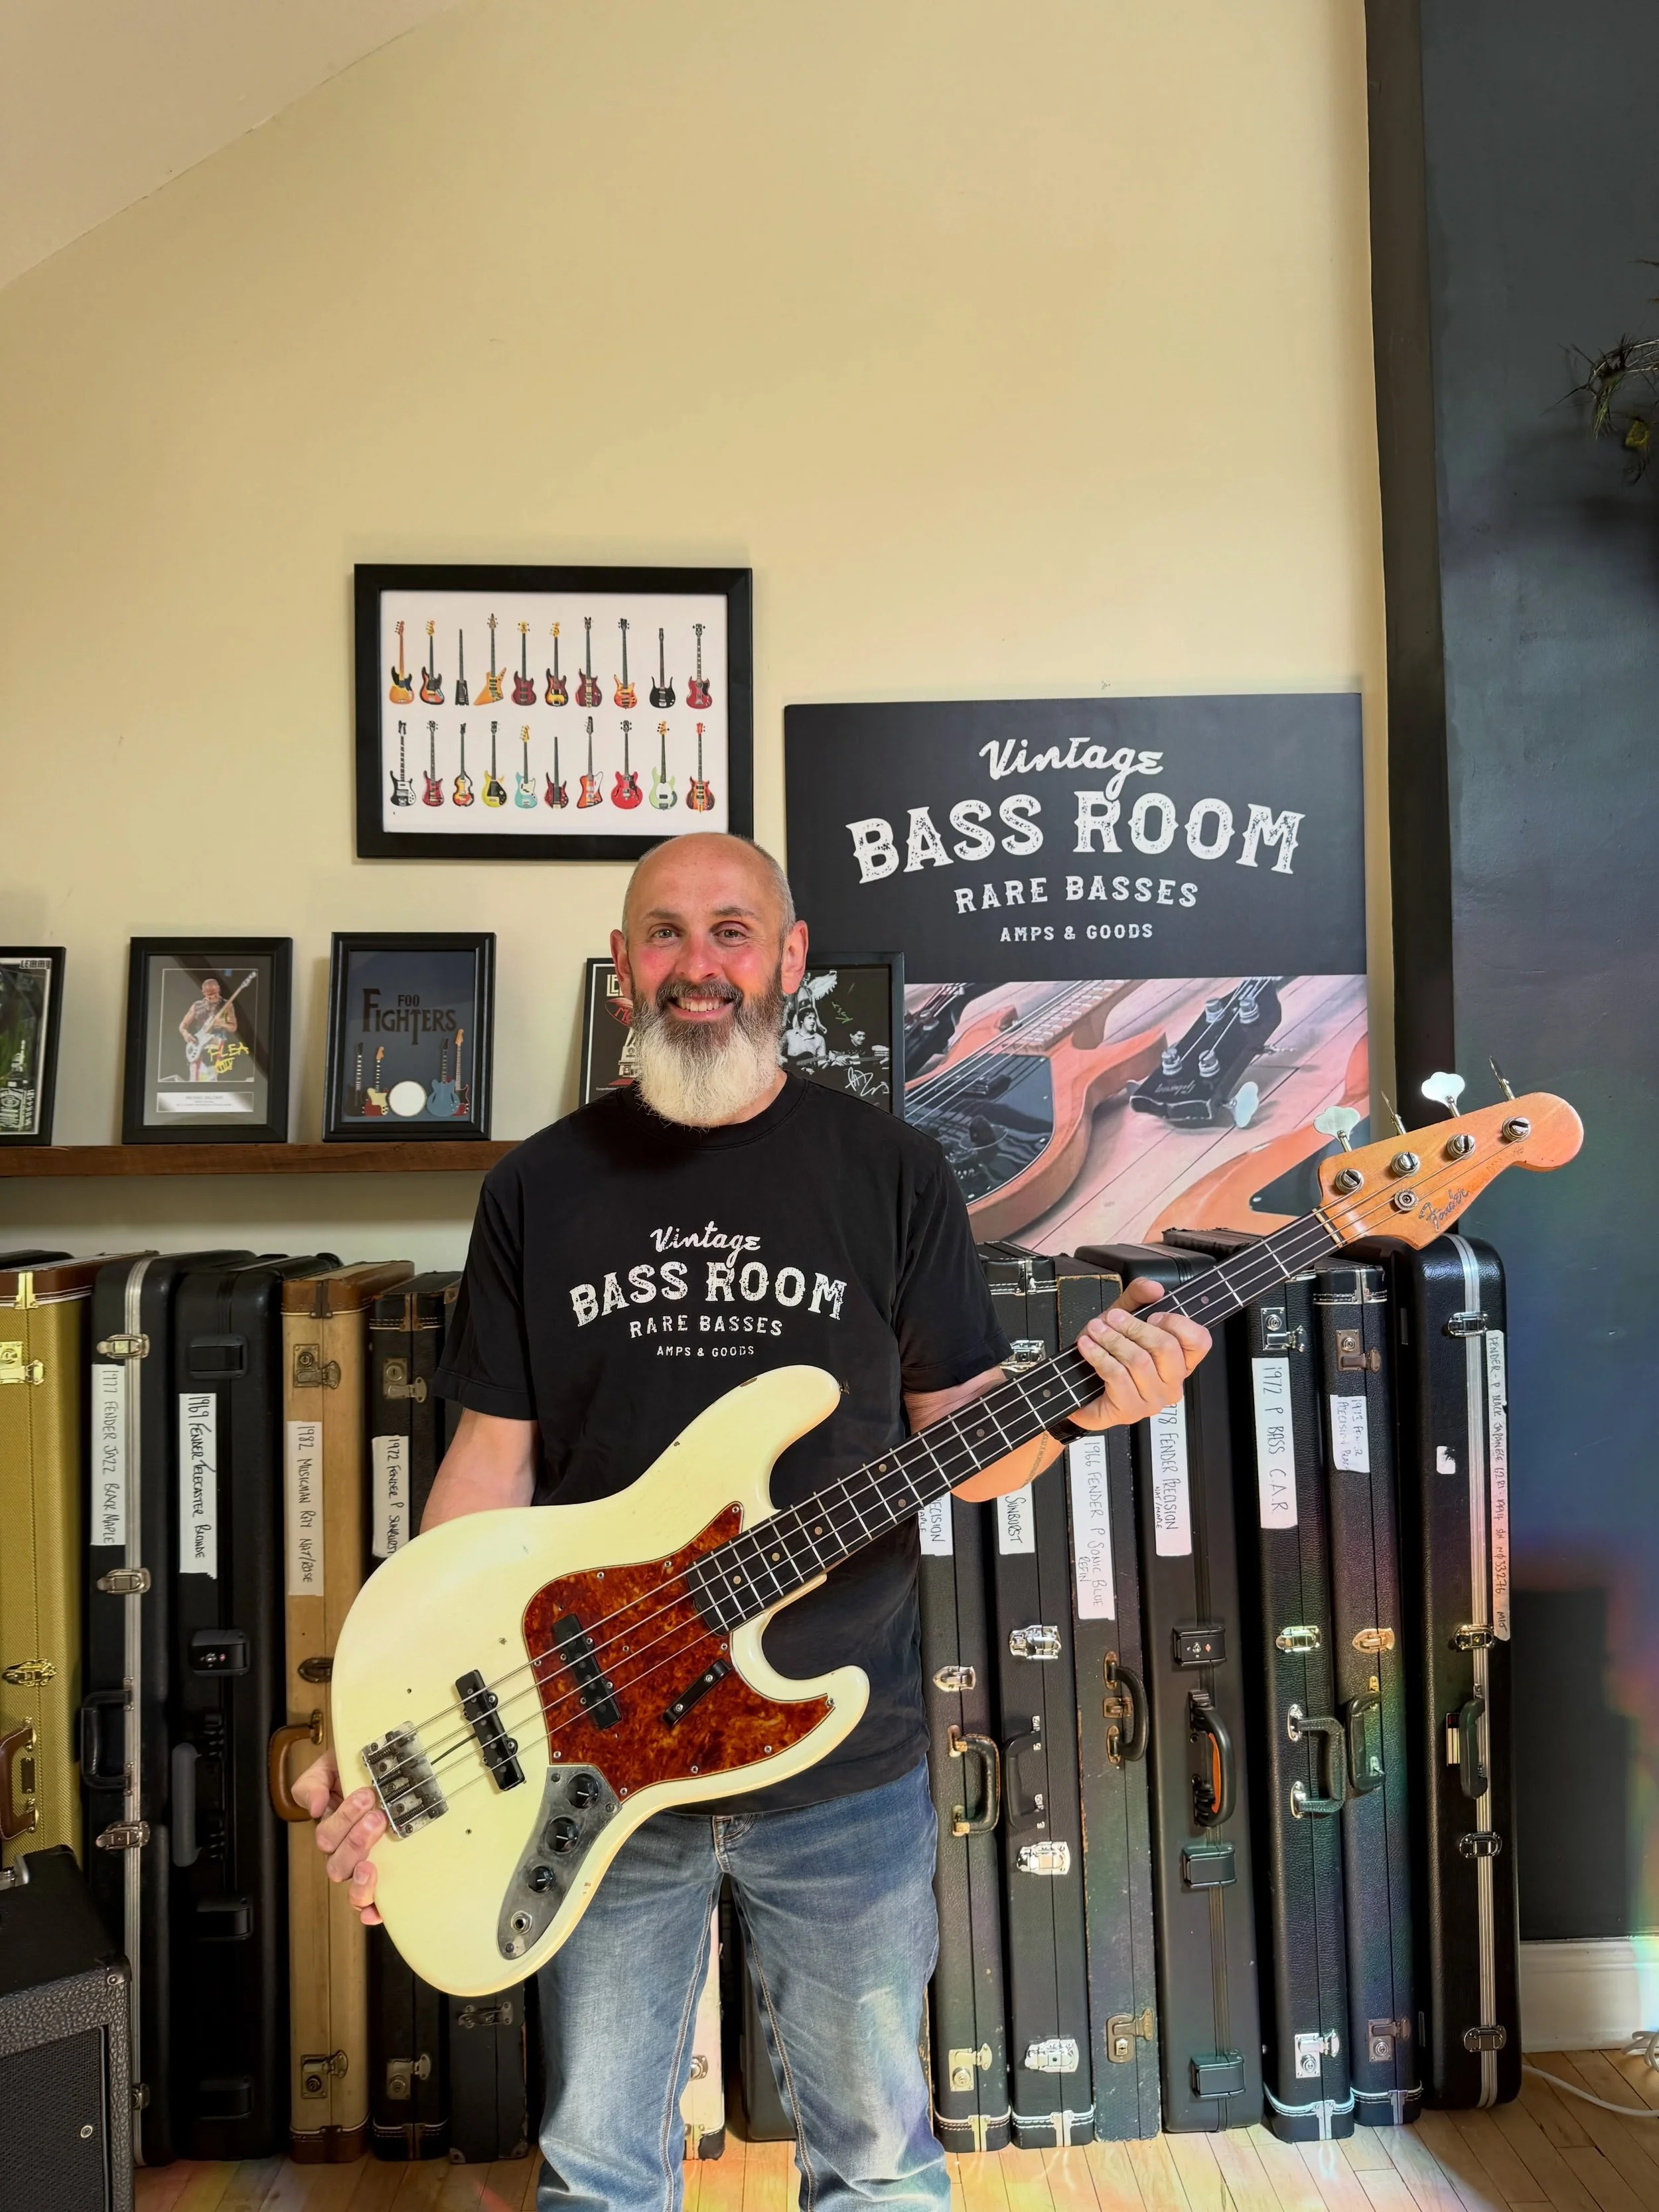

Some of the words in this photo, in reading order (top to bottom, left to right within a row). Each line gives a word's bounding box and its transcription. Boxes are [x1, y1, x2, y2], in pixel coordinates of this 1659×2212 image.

[978, 737, 1164, 802] Vintage
[845, 794, 1046, 885] BASS
[1072, 790, 1306, 875] ROOM
[954, 877, 1048, 914] RARE
[1065, 875, 1198, 908] BASSES
[1000, 926, 1054, 942] AMPS
[1064, 925, 1076, 940] &
[1086, 923, 1153, 940] GOODS
[397, 994, 420, 1007] FOO
[606, 974, 624, 997] LE
[362, 988, 457, 1045] FIGHTERS
[205, 1042, 249, 1062] FLEA
[1418, 1187, 1470, 1233] Fender
[650, 1220, 762, 1267] Vintage
[569, 1260, 689, 1328] BASS
[704, 1260, 848, 1321] ROOM
[629, 1314, 688, 1339] RARE
[699, 1314, 782, 1337] BASSES
[656, 1345, 691, 1357] AMPS
[697, 1347, 705, 1357] &
[711, 1345, 755, 1357] GOODS
[102, 1370, 119, 1393] 1977
[1263, 1366, 1283, 1395] 1972
[102, 1401, 119, 1439] FENDER
[188, 1396, 211, 1419] 1969
[188, 1422, 212, 1460] FENDER
[297, 1426, 316, 1451] 1982
[387, 1439, 400, 1461] 1972
[1084, 1441, 1101, 1467] 1966
[1159, 1433, 1179, 1473] FENDER
[1266, 1426, 1285, 1454] BASS
[102, 1445, 119, 1475] JAZZ
[103, 1483, 120, 1511] BLACK
[193, 1459, 216, 1518] TELECASTER
[297, 1459, 313, 1503] MUSICMAN
[386, 1465, 401, 1499] FENDER
[1087, 1471, 1104, 1518] FENDER
[300, 1511, 317, 1528] RAY
[930, 1495, 946, 1542] ECISION
[1005, 1496, 1027, 1544] SUNBURST
[1162, 1478, 1181, 1530] PRECISION
[102, 1514, 120, 1543] MAPLE
[194, 1524, 212, 1559] BLONDE
[1078, 1556, 1091, 1582] REFIN
[1087, 1540, 1105, 1574] SONIC
[1092, 1580, 1108, 1607] BLUE
